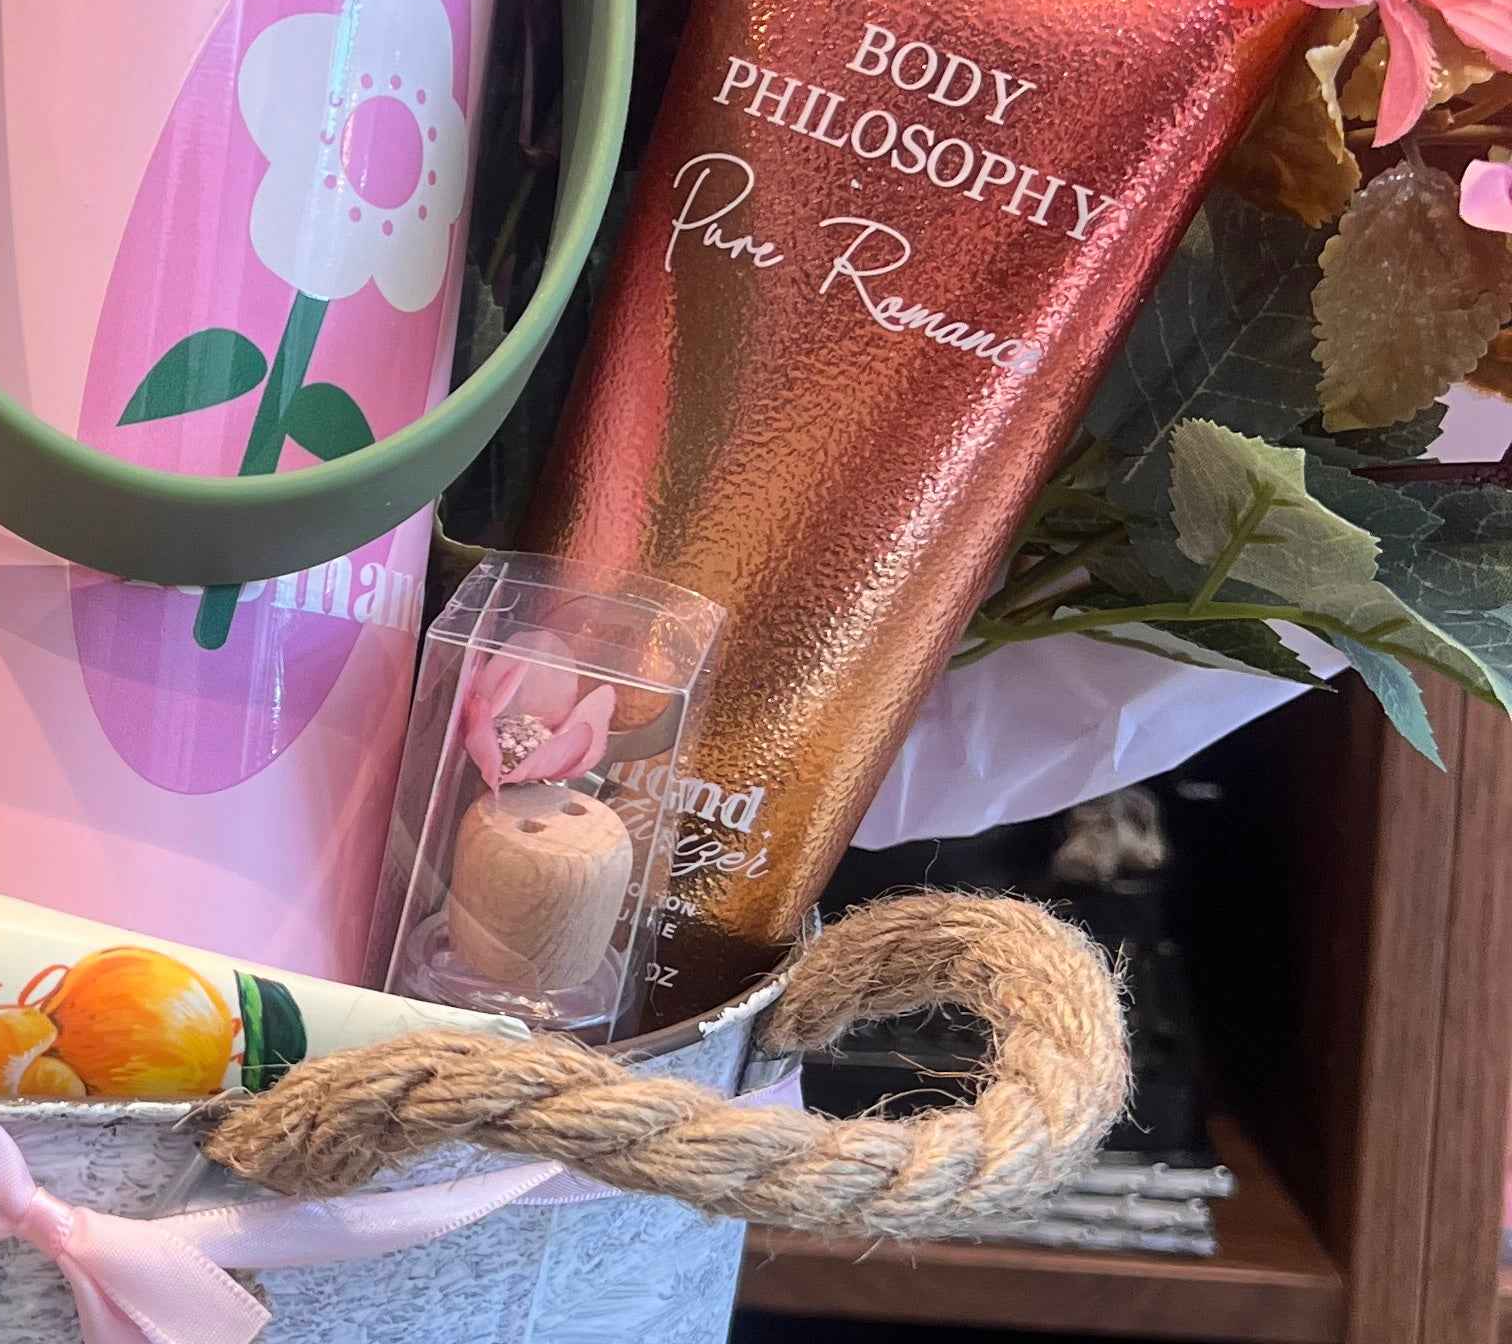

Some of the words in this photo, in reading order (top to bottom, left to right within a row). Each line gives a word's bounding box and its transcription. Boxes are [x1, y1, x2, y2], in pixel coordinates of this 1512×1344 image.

[846, 22, 1037, 126] BODY
[712, 56, 1121, 242] PHILOSOPHY
[665, 152, 785, 273] Pure
